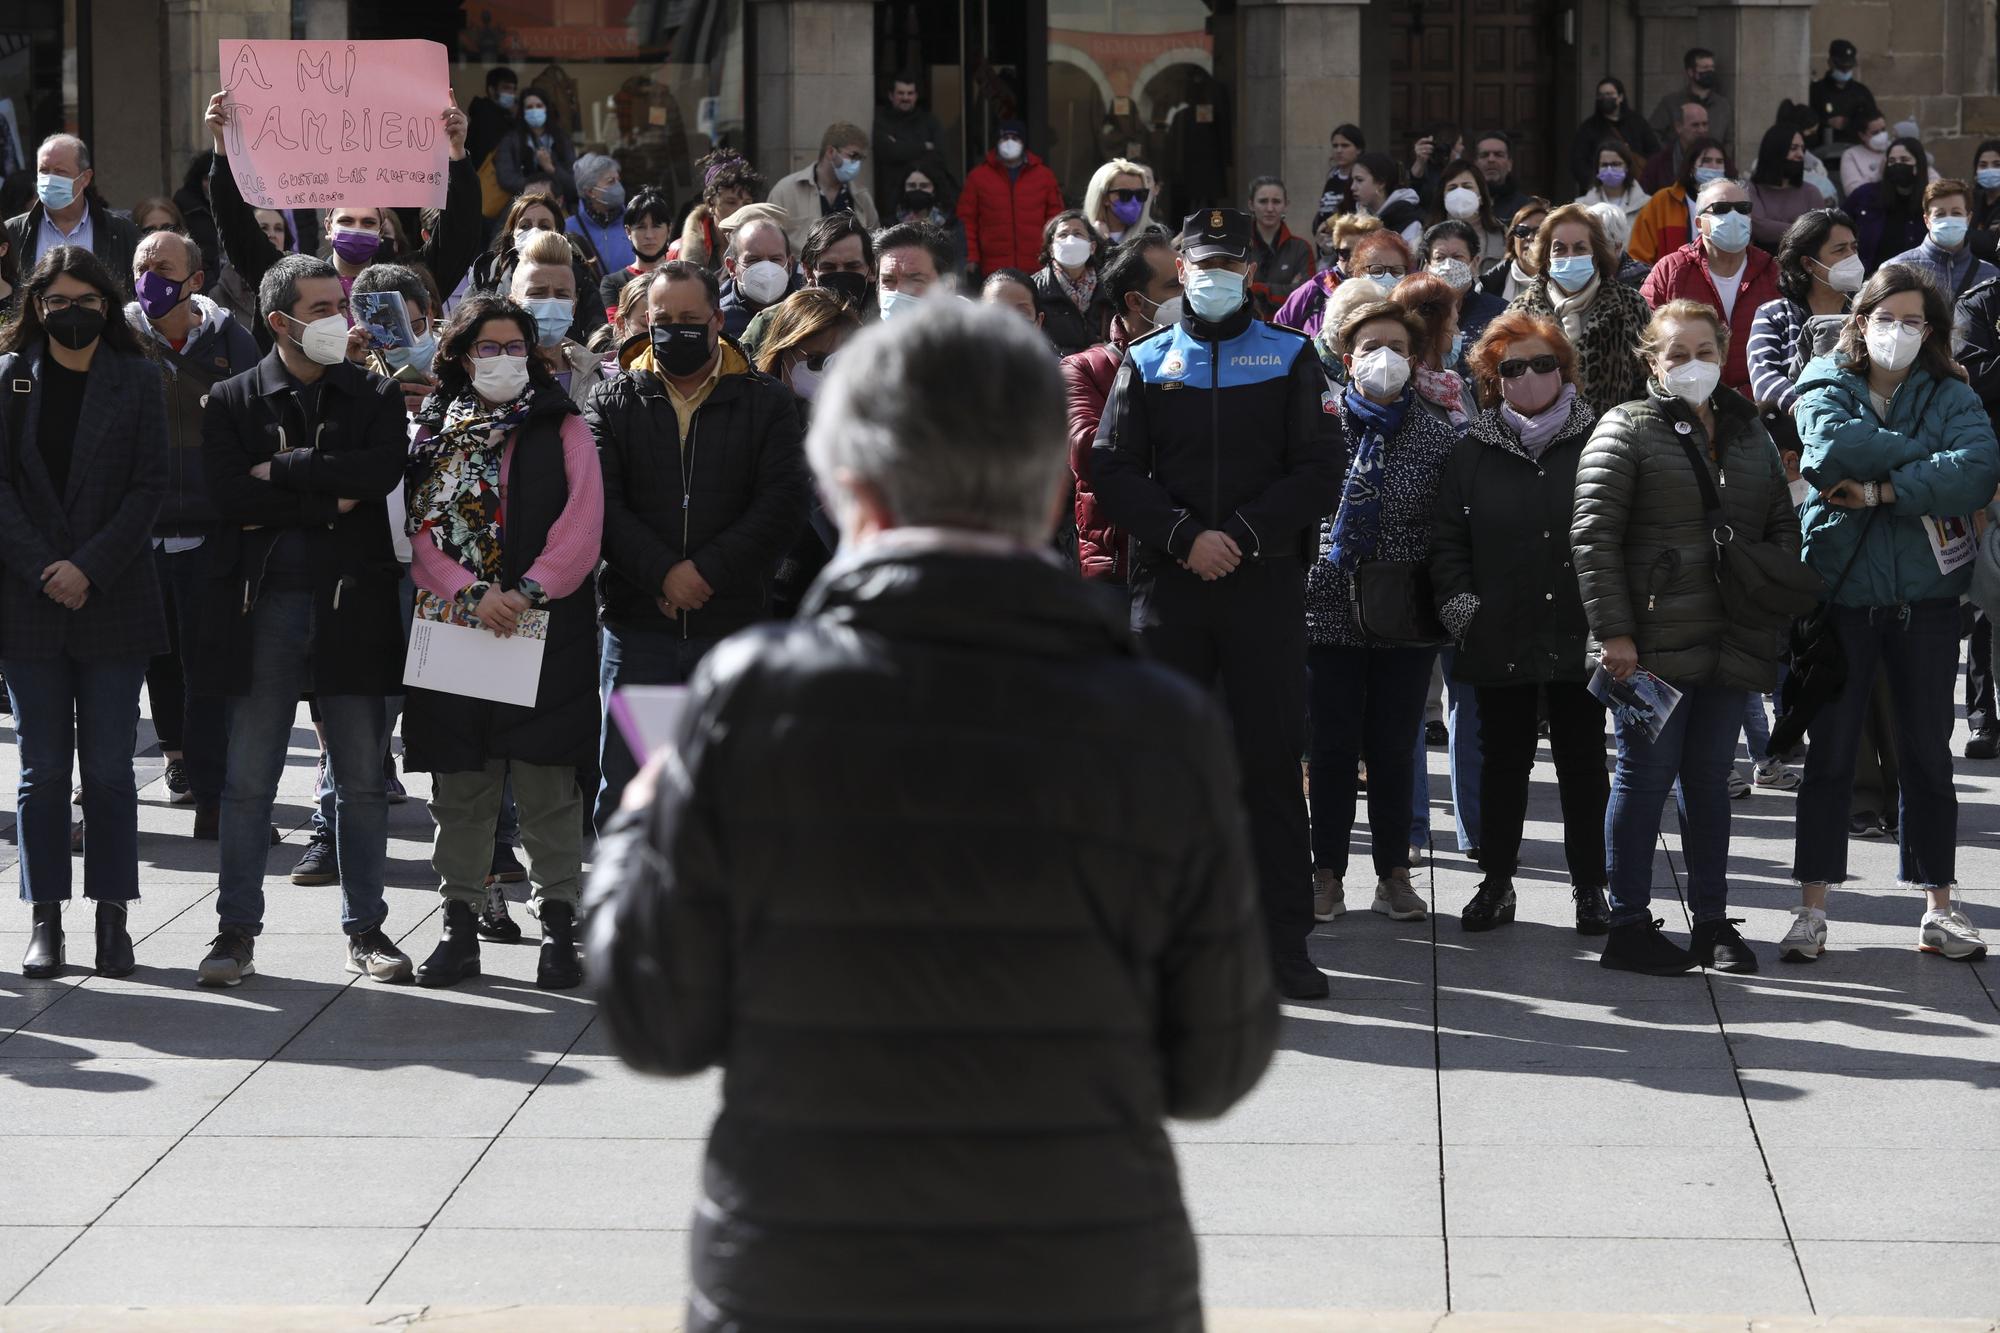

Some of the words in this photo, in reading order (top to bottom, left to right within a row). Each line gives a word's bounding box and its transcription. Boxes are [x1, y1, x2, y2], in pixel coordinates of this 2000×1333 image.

[223, 44, 273, 91] A
[239, 171, 267, 194] ME
[278, 172, 329, 190] GUSTAN
[337, 167, 367, 184] LAS
[1231, 353, 1282, 366] POLICÍA
